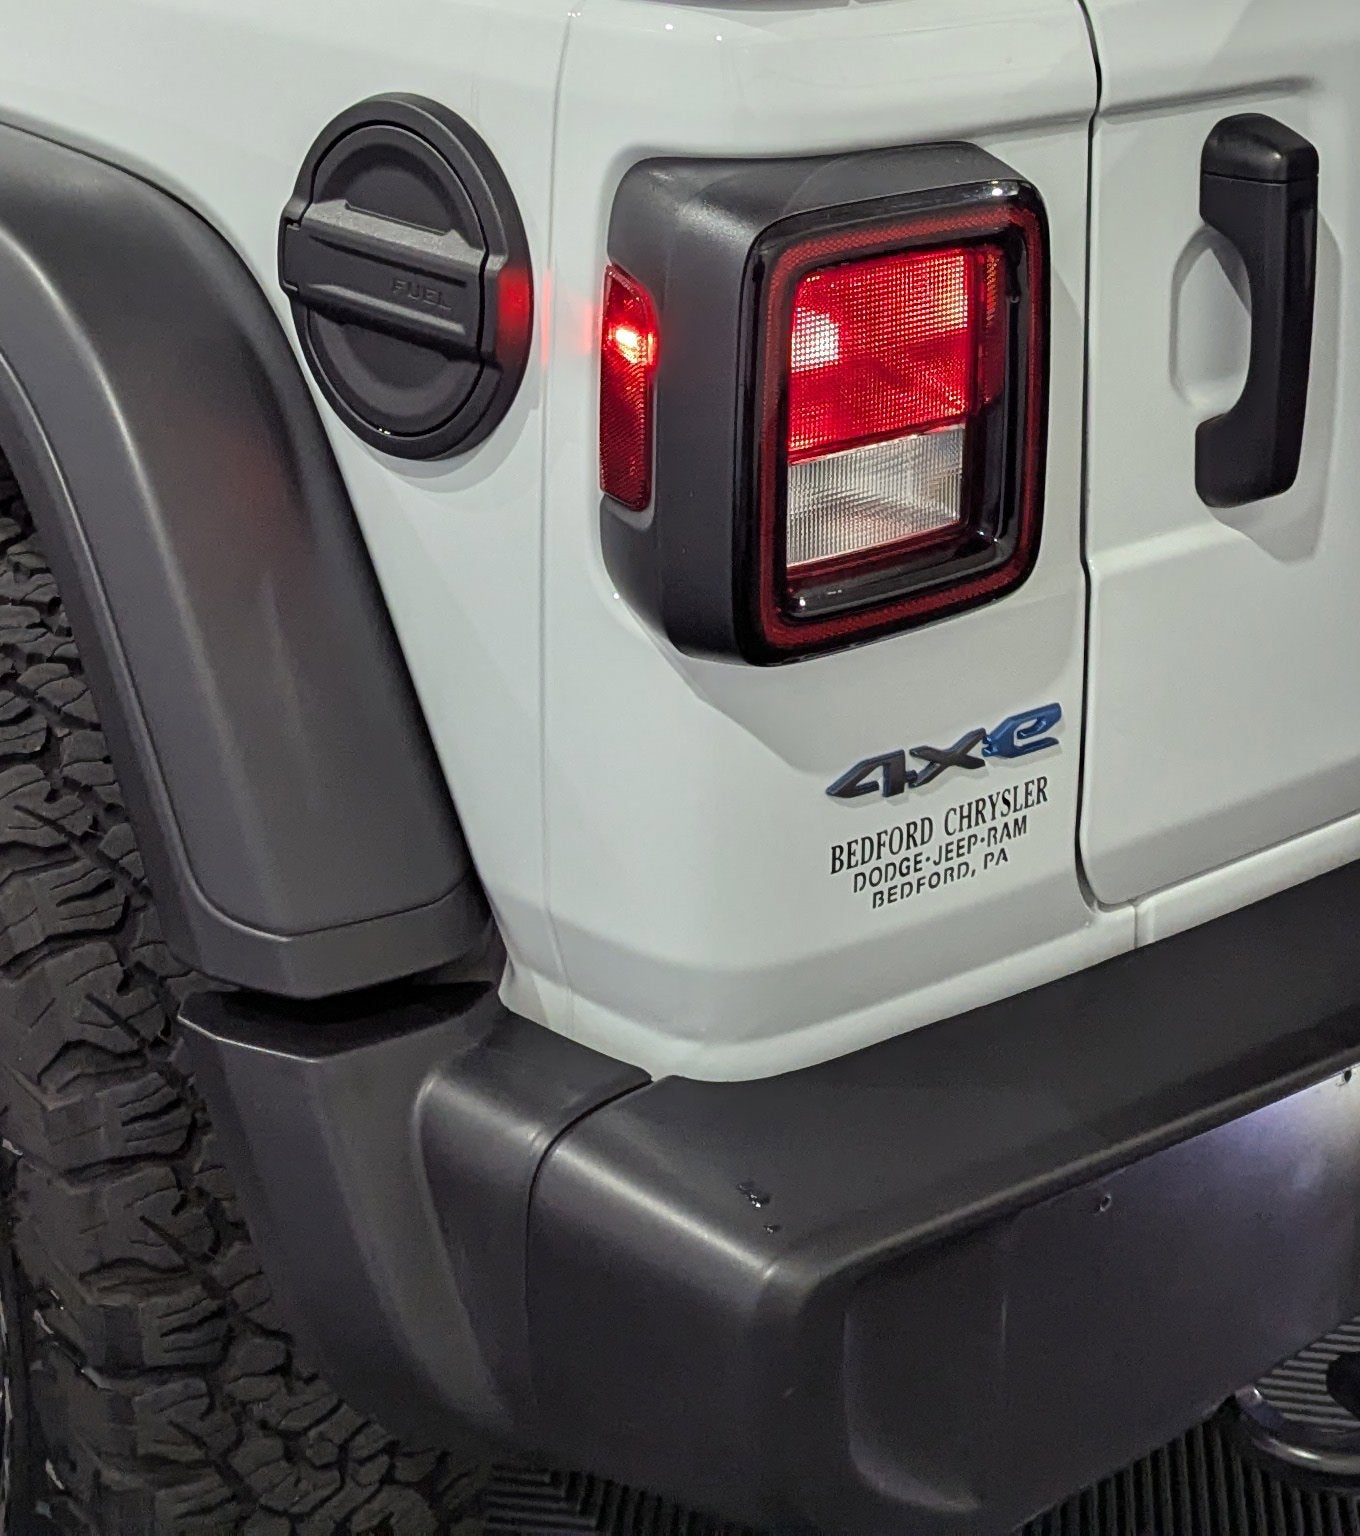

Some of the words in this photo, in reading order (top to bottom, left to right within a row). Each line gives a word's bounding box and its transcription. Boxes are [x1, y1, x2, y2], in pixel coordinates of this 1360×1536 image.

[391, 279, 452, 311] FUEL
[830, 816, 934, 875] BEDFORD
[944, 775, 1048, 837] CHRYSLER
[872, 862, 977, 909] BEDFORD,
[983, 848, 1008, 870] PA
